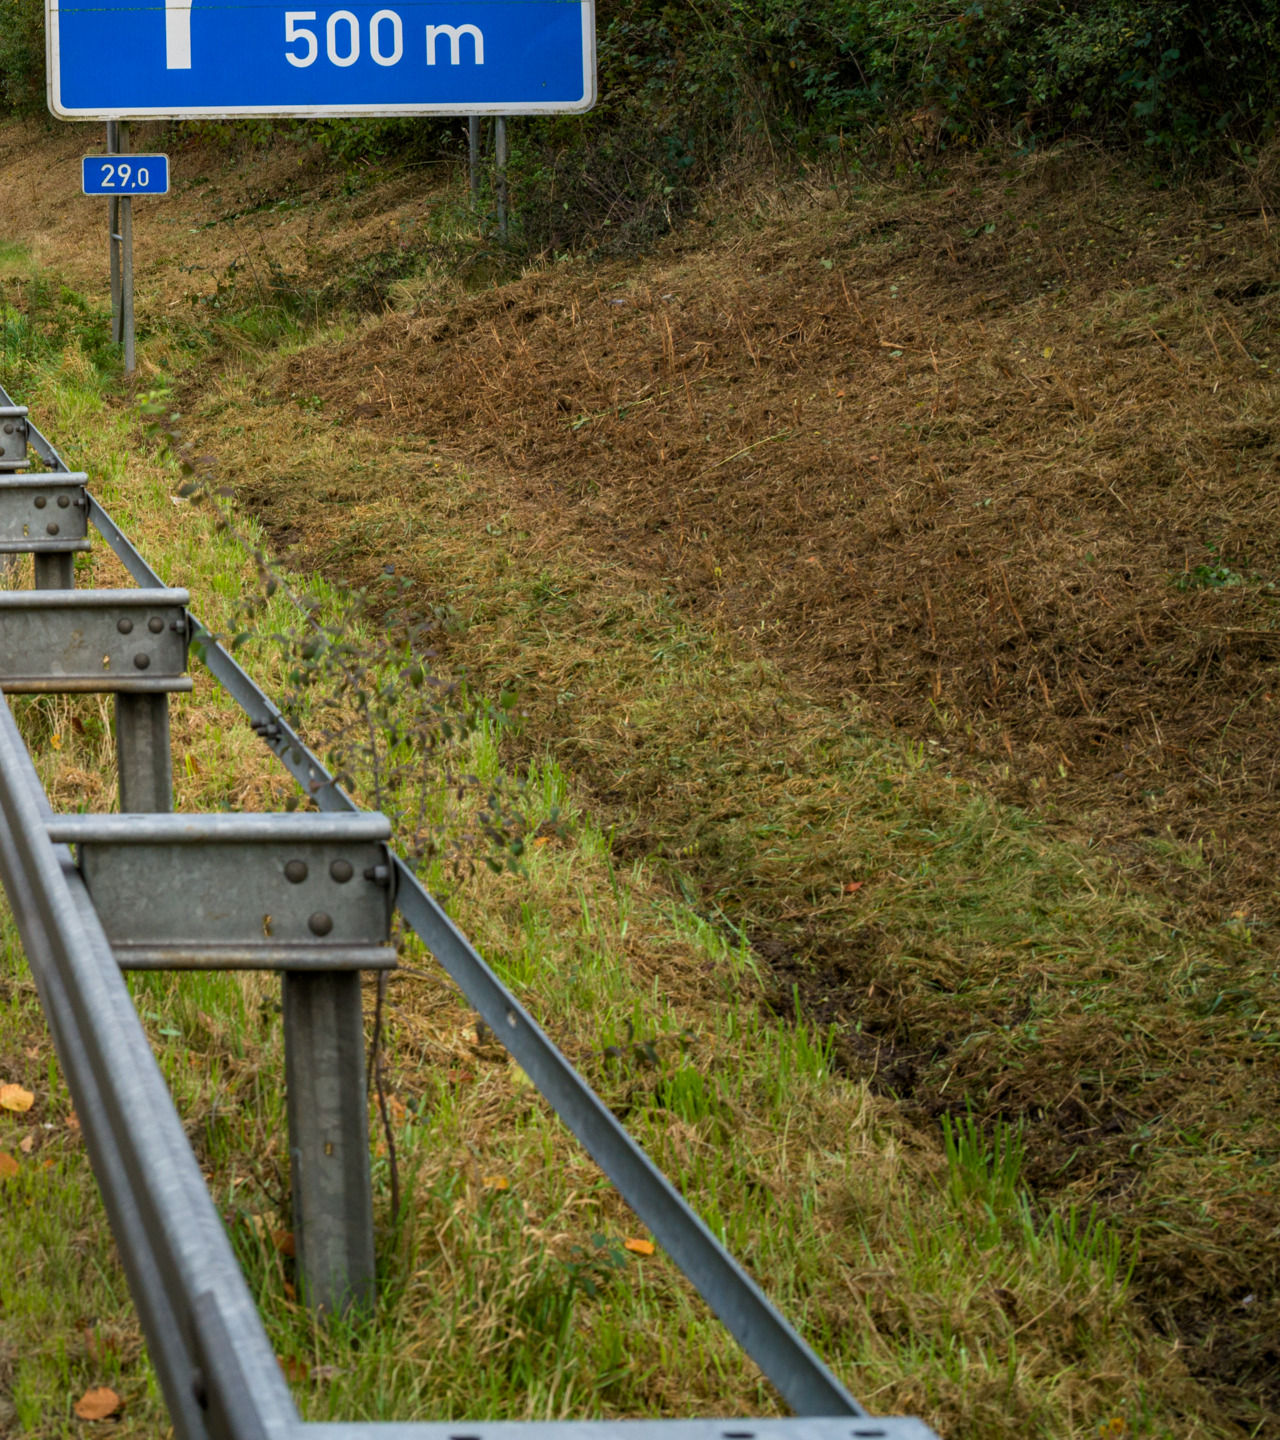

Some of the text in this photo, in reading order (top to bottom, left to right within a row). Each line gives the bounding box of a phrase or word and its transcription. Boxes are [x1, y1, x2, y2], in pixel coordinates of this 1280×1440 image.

[285, 9, 484, 68] 500 m
[100, 163, 149, 189] 29,0
